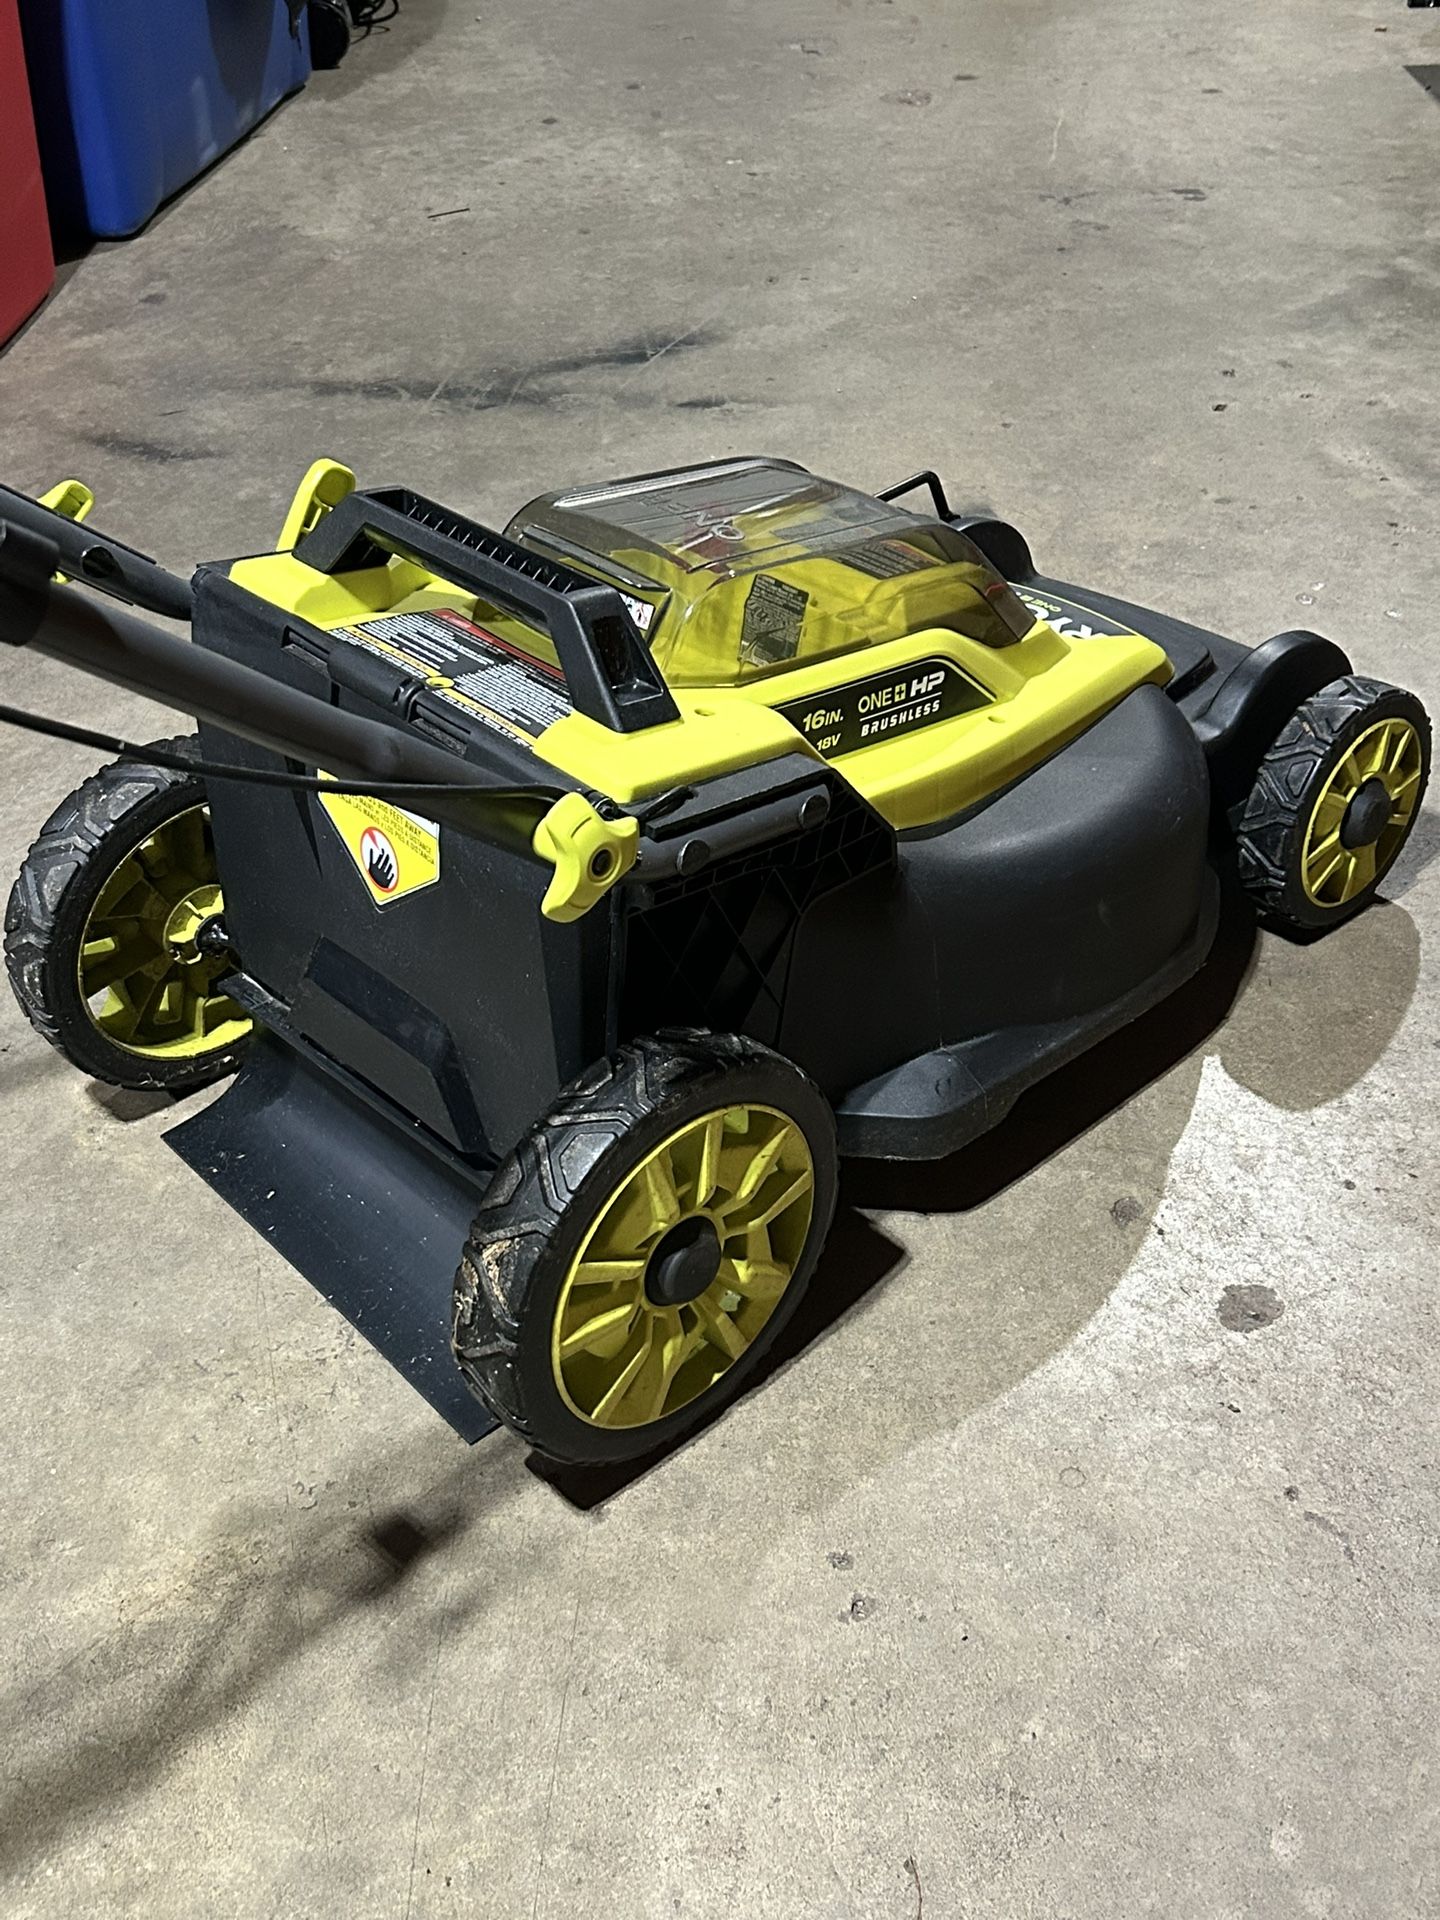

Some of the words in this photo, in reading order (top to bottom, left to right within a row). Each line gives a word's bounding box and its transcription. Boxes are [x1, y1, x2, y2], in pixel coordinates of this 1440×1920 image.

[802, 708, 844, 732] 16IN.
[910, 670, 946, 698] HP
[816, 733, 841, 751] 18V
[861, 699, 941, 737] BRUSHLESS
